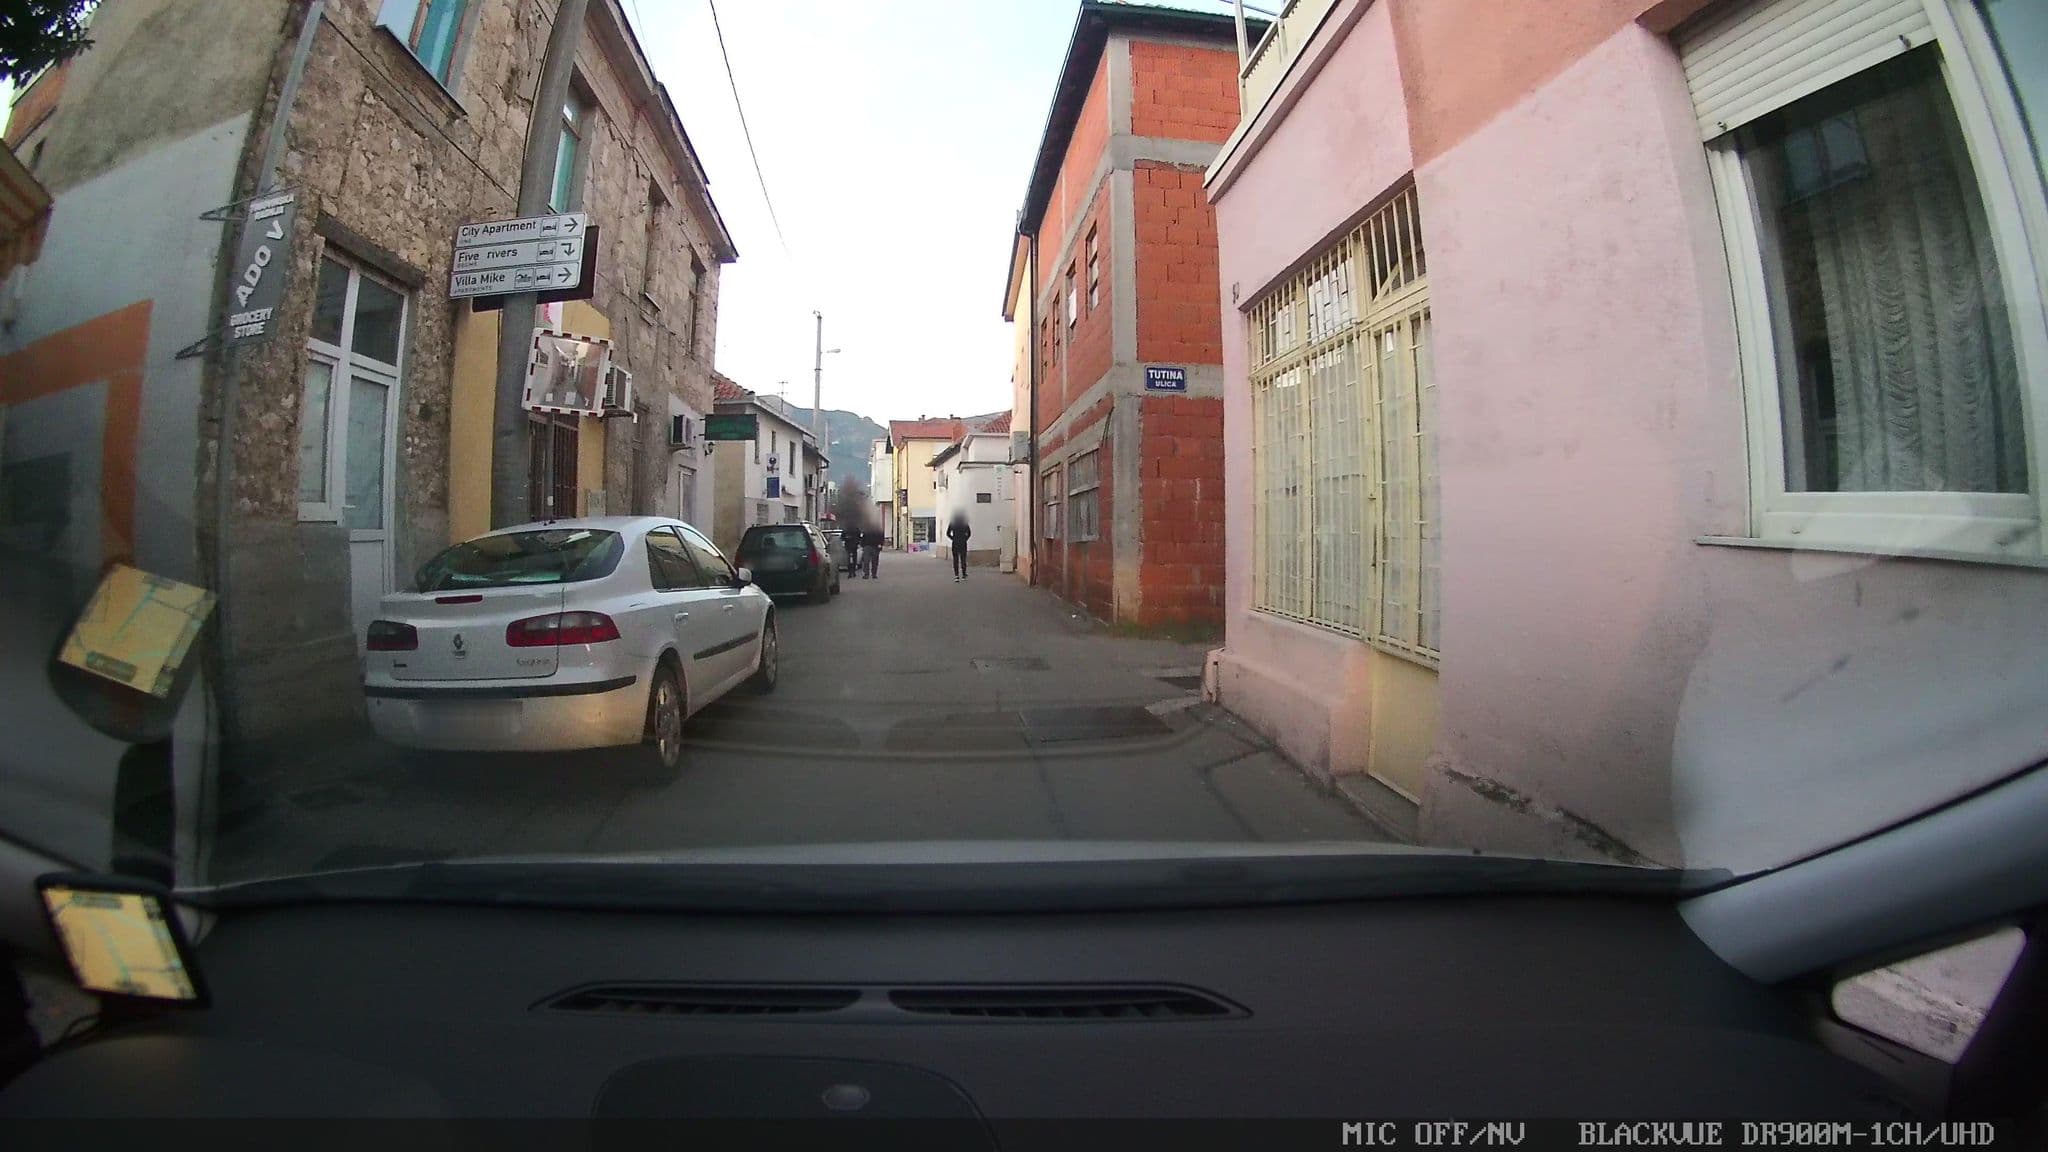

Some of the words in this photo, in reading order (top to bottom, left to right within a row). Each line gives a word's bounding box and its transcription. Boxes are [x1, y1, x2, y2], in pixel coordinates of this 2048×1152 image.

[462, 226, 480, 237] City
[482, 221, 536, 235] Apartment
[458, 252, 480, 262] Five
[487, 248, 518, 259] rivers
[236, 246, 271, 308] ADO
[455, 275, 477, 287] Villa
[480, 272, 505, 284] Mike
[234, 321, 265, 339] STORE
[1148, 369, 1183, 380] TUTINA
